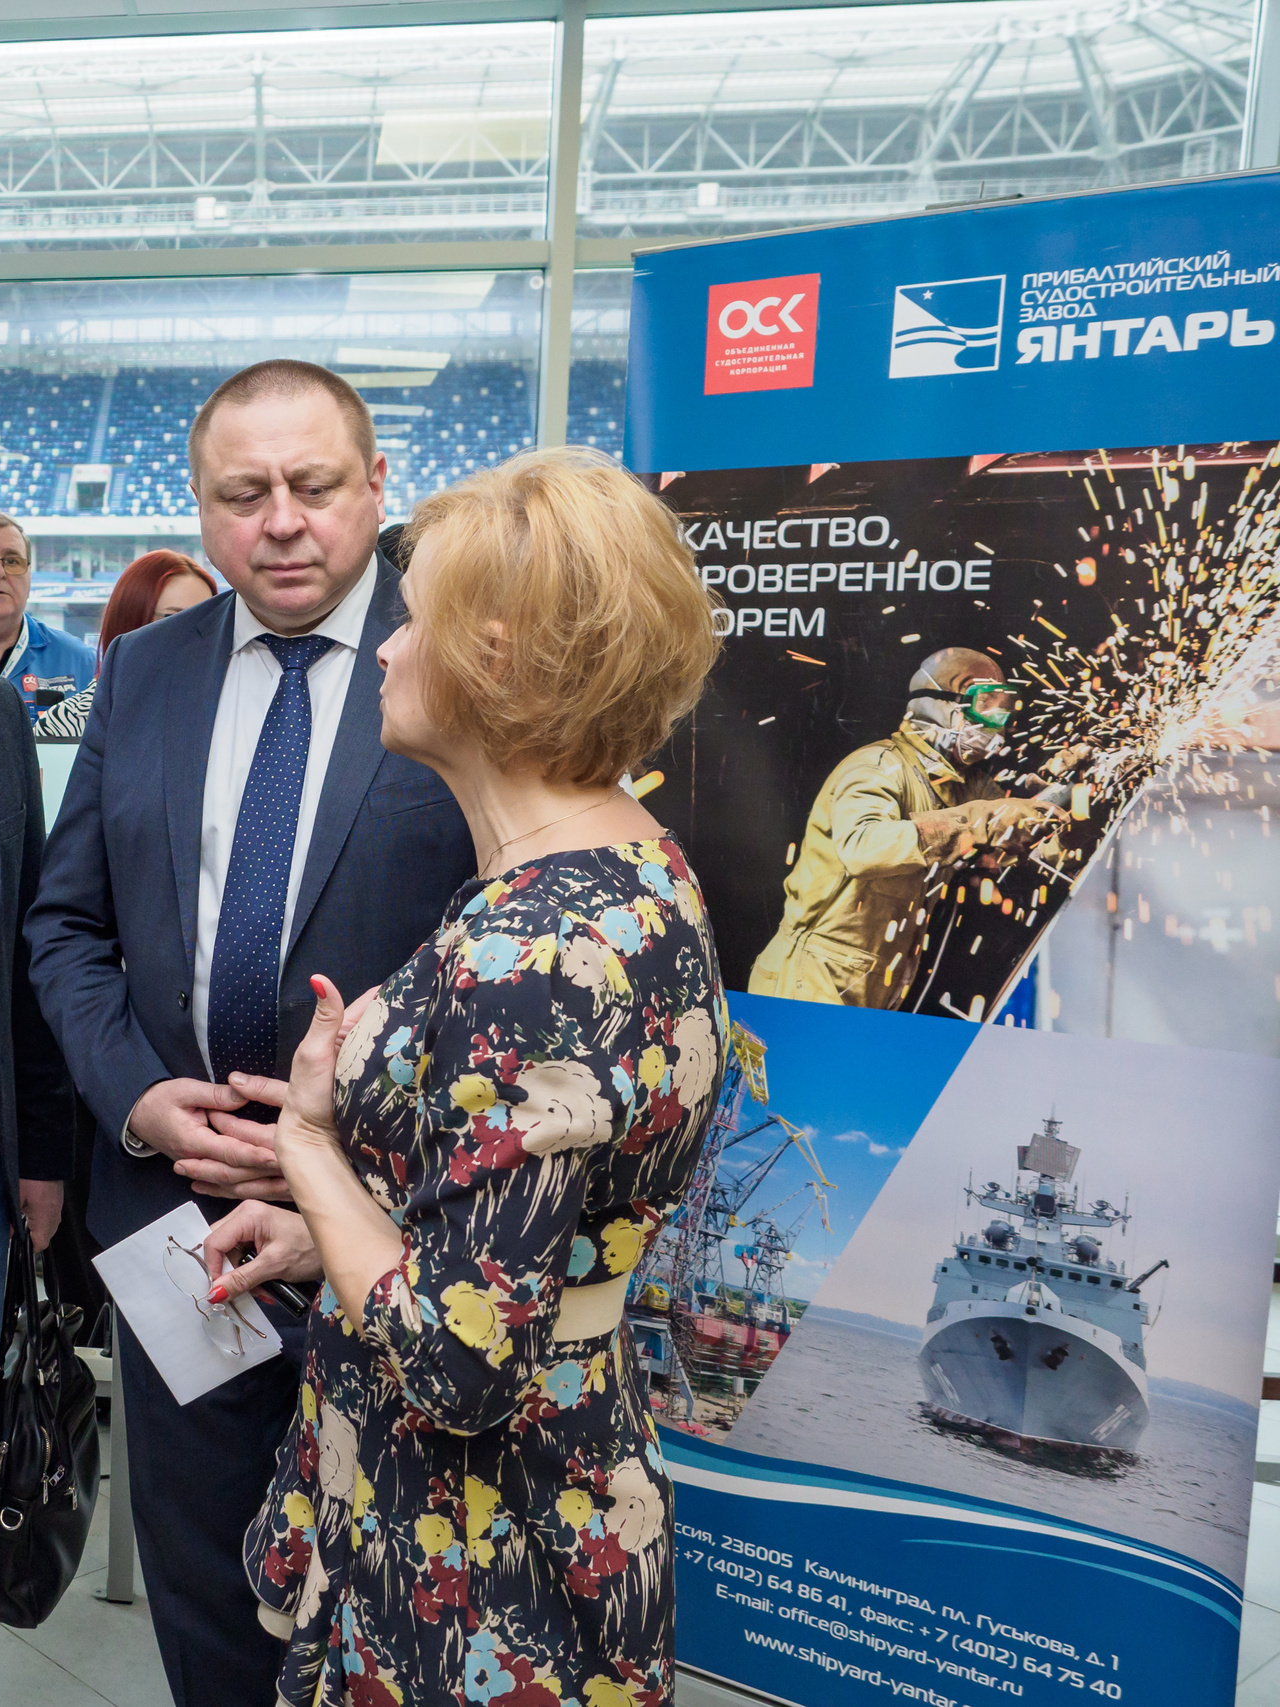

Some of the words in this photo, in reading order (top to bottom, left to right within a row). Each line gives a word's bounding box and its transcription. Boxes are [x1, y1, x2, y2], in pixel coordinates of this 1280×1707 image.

[1020, 262, 1280, 306] СУДОСТРОИТЕЛЬНЫЙ
[1021, 249, 1231, 290] ПРИБАЛТИЙСКИЙ
[718, 293, 806, 339] ОСК
[1019, 301, 1098, 324] ЗАВОД
[725, 342, 795, 355] ОБЪЕДИНЕННАЯ
[1015, 308, 1276, 365] ЯНТАРЬ
[715, 352, 805, 367] СУДОСТРОИТЕЛЬНАЯ
[730, 364, 788, 376] КОРПОРАЦИЯ
[678, 515, 900, 550] КАЧЕСТВО,
[694, 559, 993, 594] РОВЕРЕННОЕ
[721, 1535, 792, 1568] 236005
[805, 1559, 935, 1614] Калининград,
[942, 1606, 970, 1625] пл.
[977, 1615, 1079, 1660] Гуськова,
[1086, 1652, 1104, 1666] д.
[1112, 1655, 1118, 1670] 1
[684, 1550, 704, 1563] +7
[708, 1556, 762, 1586] (4012)
[768, 1575, 792, 1593] 64
[798, 1584, 822, 1602] 86
[861, 1606, 913, 1633] факс:
[952, 1635, 1017, 1668] (4012)
[1023, 1657, 1052, 1677] 64
[1058, 1667, 1084, 1688] 75
[1090, 1680, 1121, 1699] 40
[717, 1584, 773, 1613] E-mail:
[779, 1607, 1022, 1696] office@shipyard-yantar.ru
